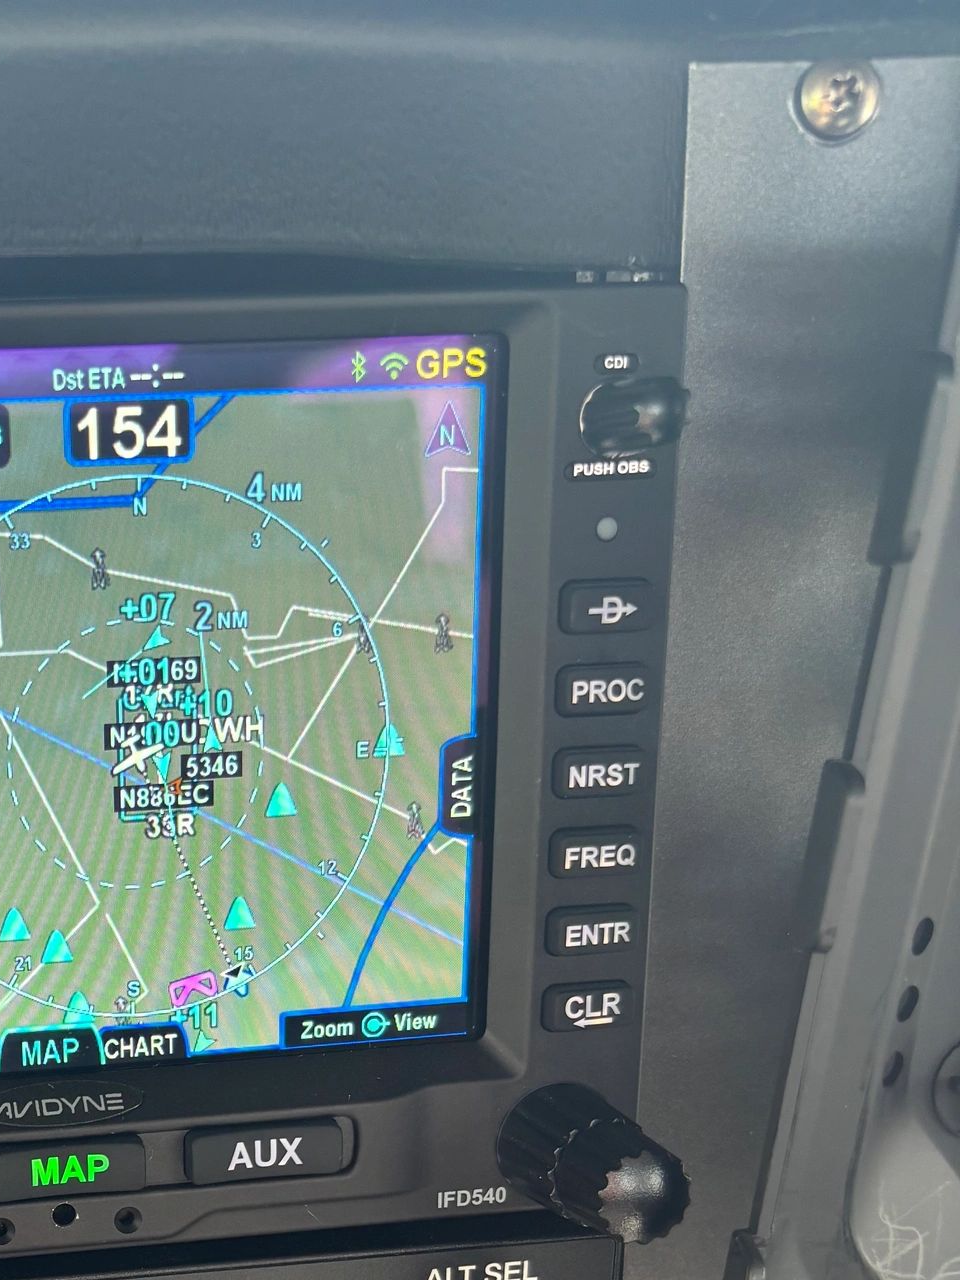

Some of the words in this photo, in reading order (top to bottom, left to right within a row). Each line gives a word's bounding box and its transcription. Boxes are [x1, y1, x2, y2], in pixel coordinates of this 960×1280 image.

[416, 348, 488, 380] GPS
[603, 356, 629, 370] CDI
[52, 367, 85, 392] Dst
[90, 366, 126, 390] ETA
[76, 402, 183, 461] 154
[572, 462, 616, 478] PUSH
[617, 459, 651, 475] OBS
[246, 471, 266, 502] 4
[270, 482, 303, 503] NM
[216, 609, 249, 630] NM
[571, 678, 645, 704] PROC
[185, 753, 239, 779] 5346
[568, 762, 640, 789] NRST
[449, 754, 474, 821] DATA
[317, 860, 338, 877] 12
[564, 843, 636, 871] FREQ
[564, 920, 632, 948] ENTR
[564, 992, 623, 1020] CLR
[300, 1019, 354, 1040] Zoom
[394, 1012, 438, 1033] View
[21, 1039, 80, 1068] MAP
[104, 1032, 178, 1062] CHART
[227, 1136, 304, 1171] AUX
[30, 1154, 110, 1187] MAP
[436, 1186, 508, 1209] IFD540
